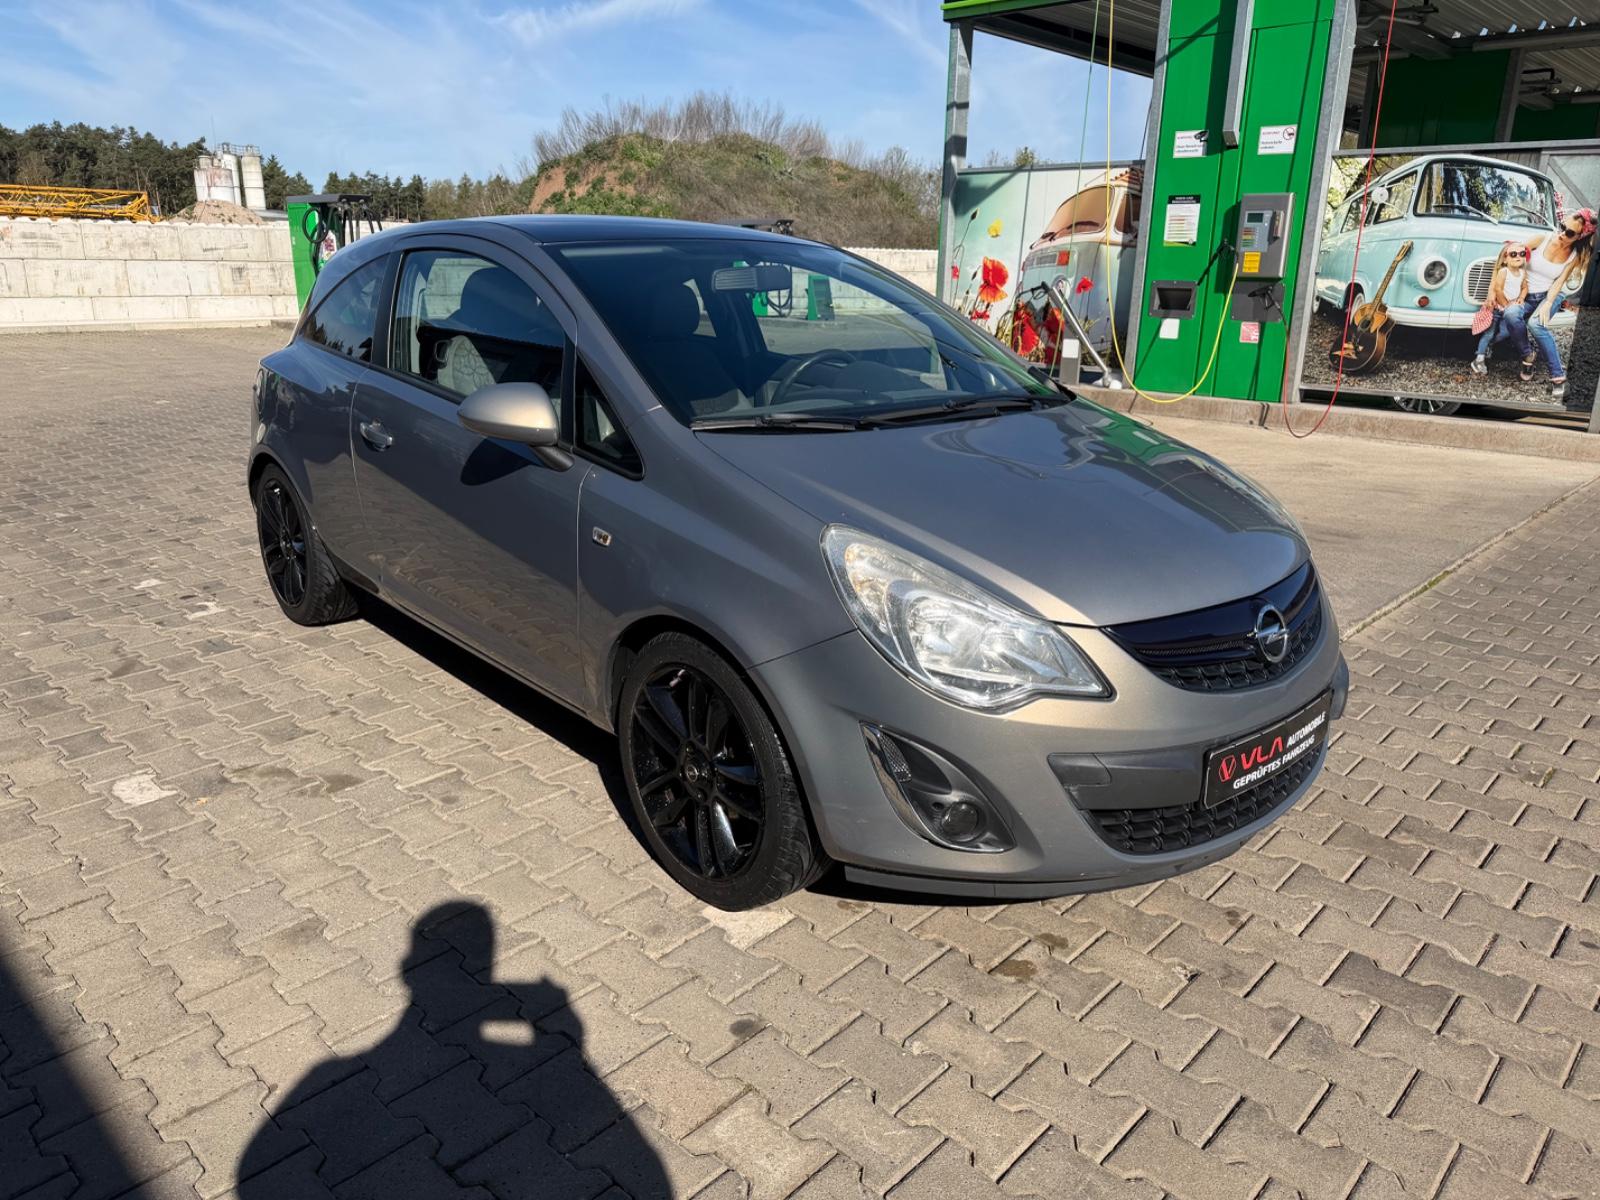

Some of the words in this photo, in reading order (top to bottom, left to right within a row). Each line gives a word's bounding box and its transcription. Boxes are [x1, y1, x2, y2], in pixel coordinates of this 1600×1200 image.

[1233, 758, 1281, 789] GEPRÜFTES
[1282, 735, 1315, 765] FAHRZEUG
[1241, 736, 1283, 771] VLA
[1286, 711, 1326, 748] AUTOMOBILE
